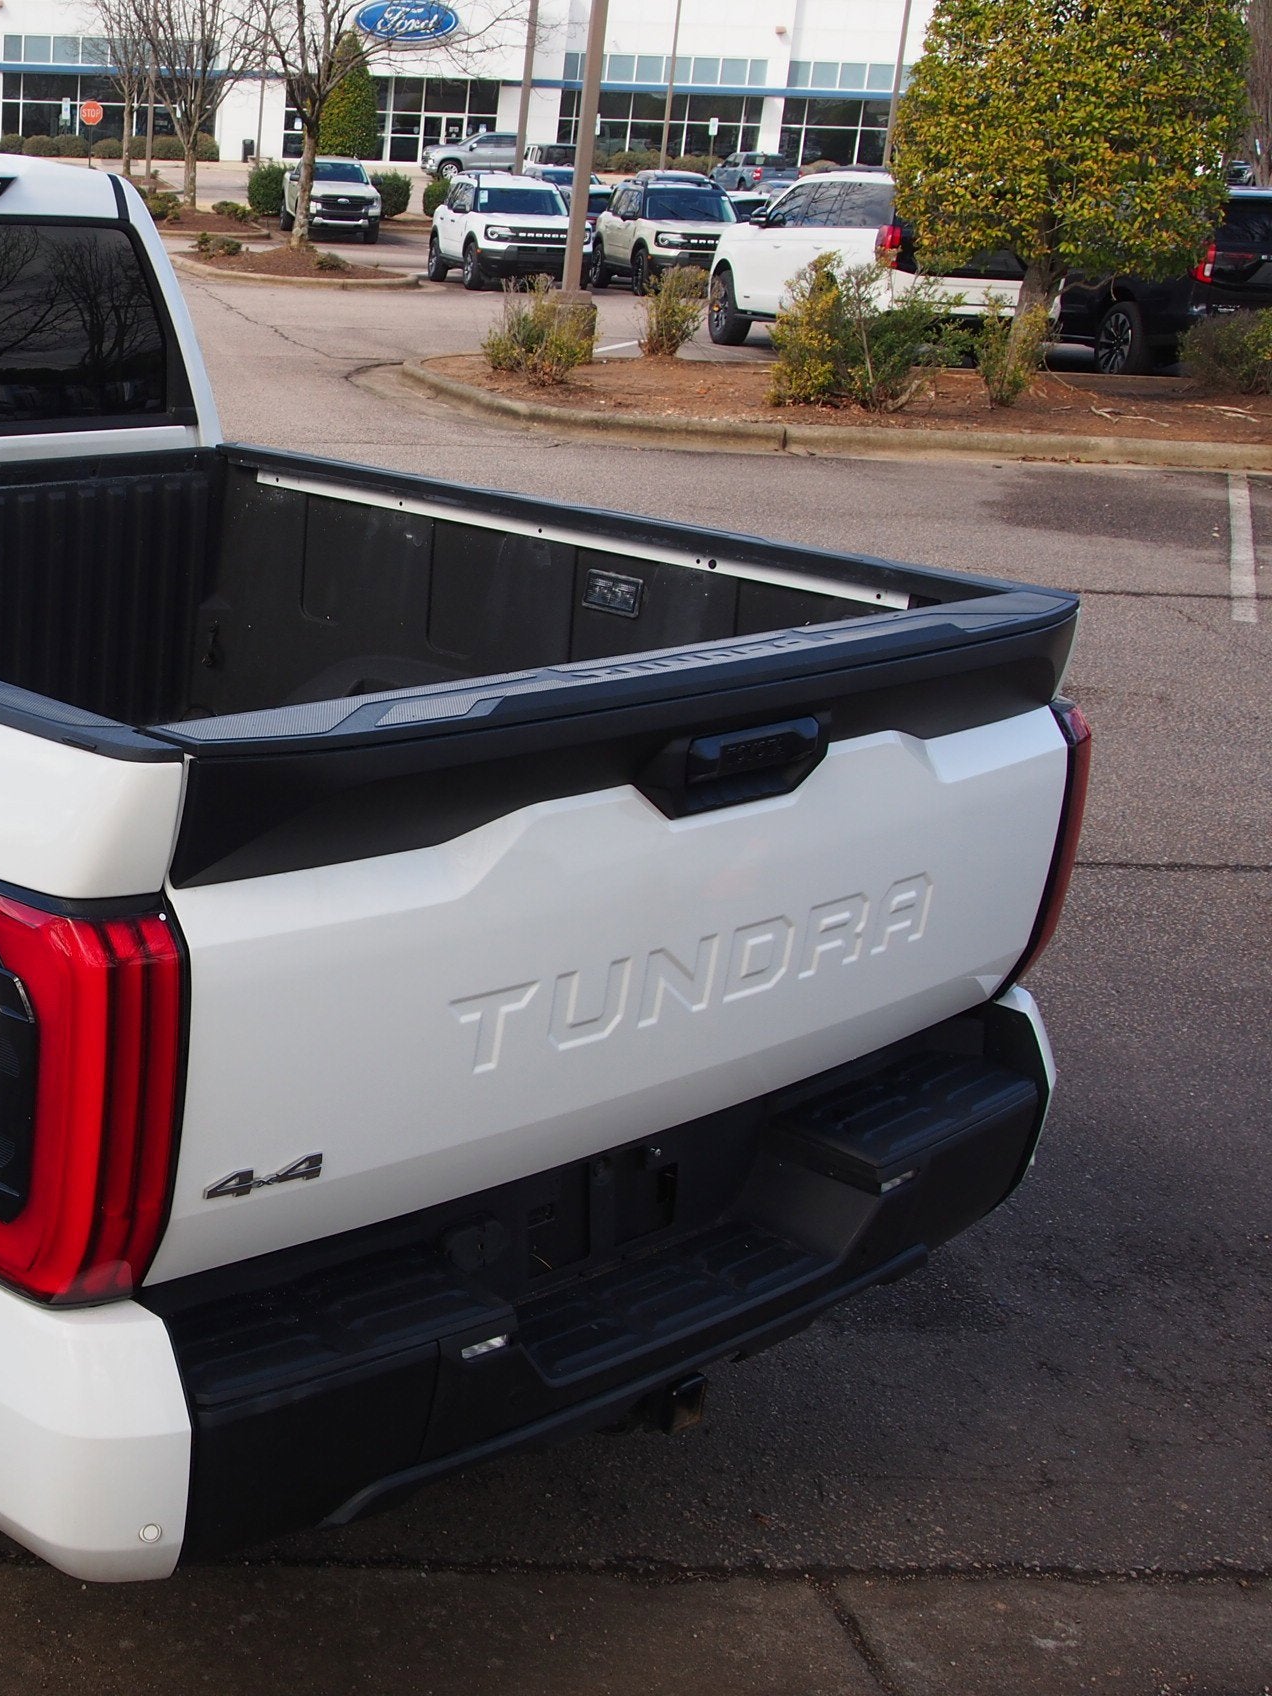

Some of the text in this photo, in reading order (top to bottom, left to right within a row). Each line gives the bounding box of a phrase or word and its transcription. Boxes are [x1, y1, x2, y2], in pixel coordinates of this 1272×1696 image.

[377, 6, 439, 33] Ford
[82, 108, 100, 118] STOP
[447, 871, 935, 1075] TUNDRA
[202, 1151, 323, 1200] 4x4
